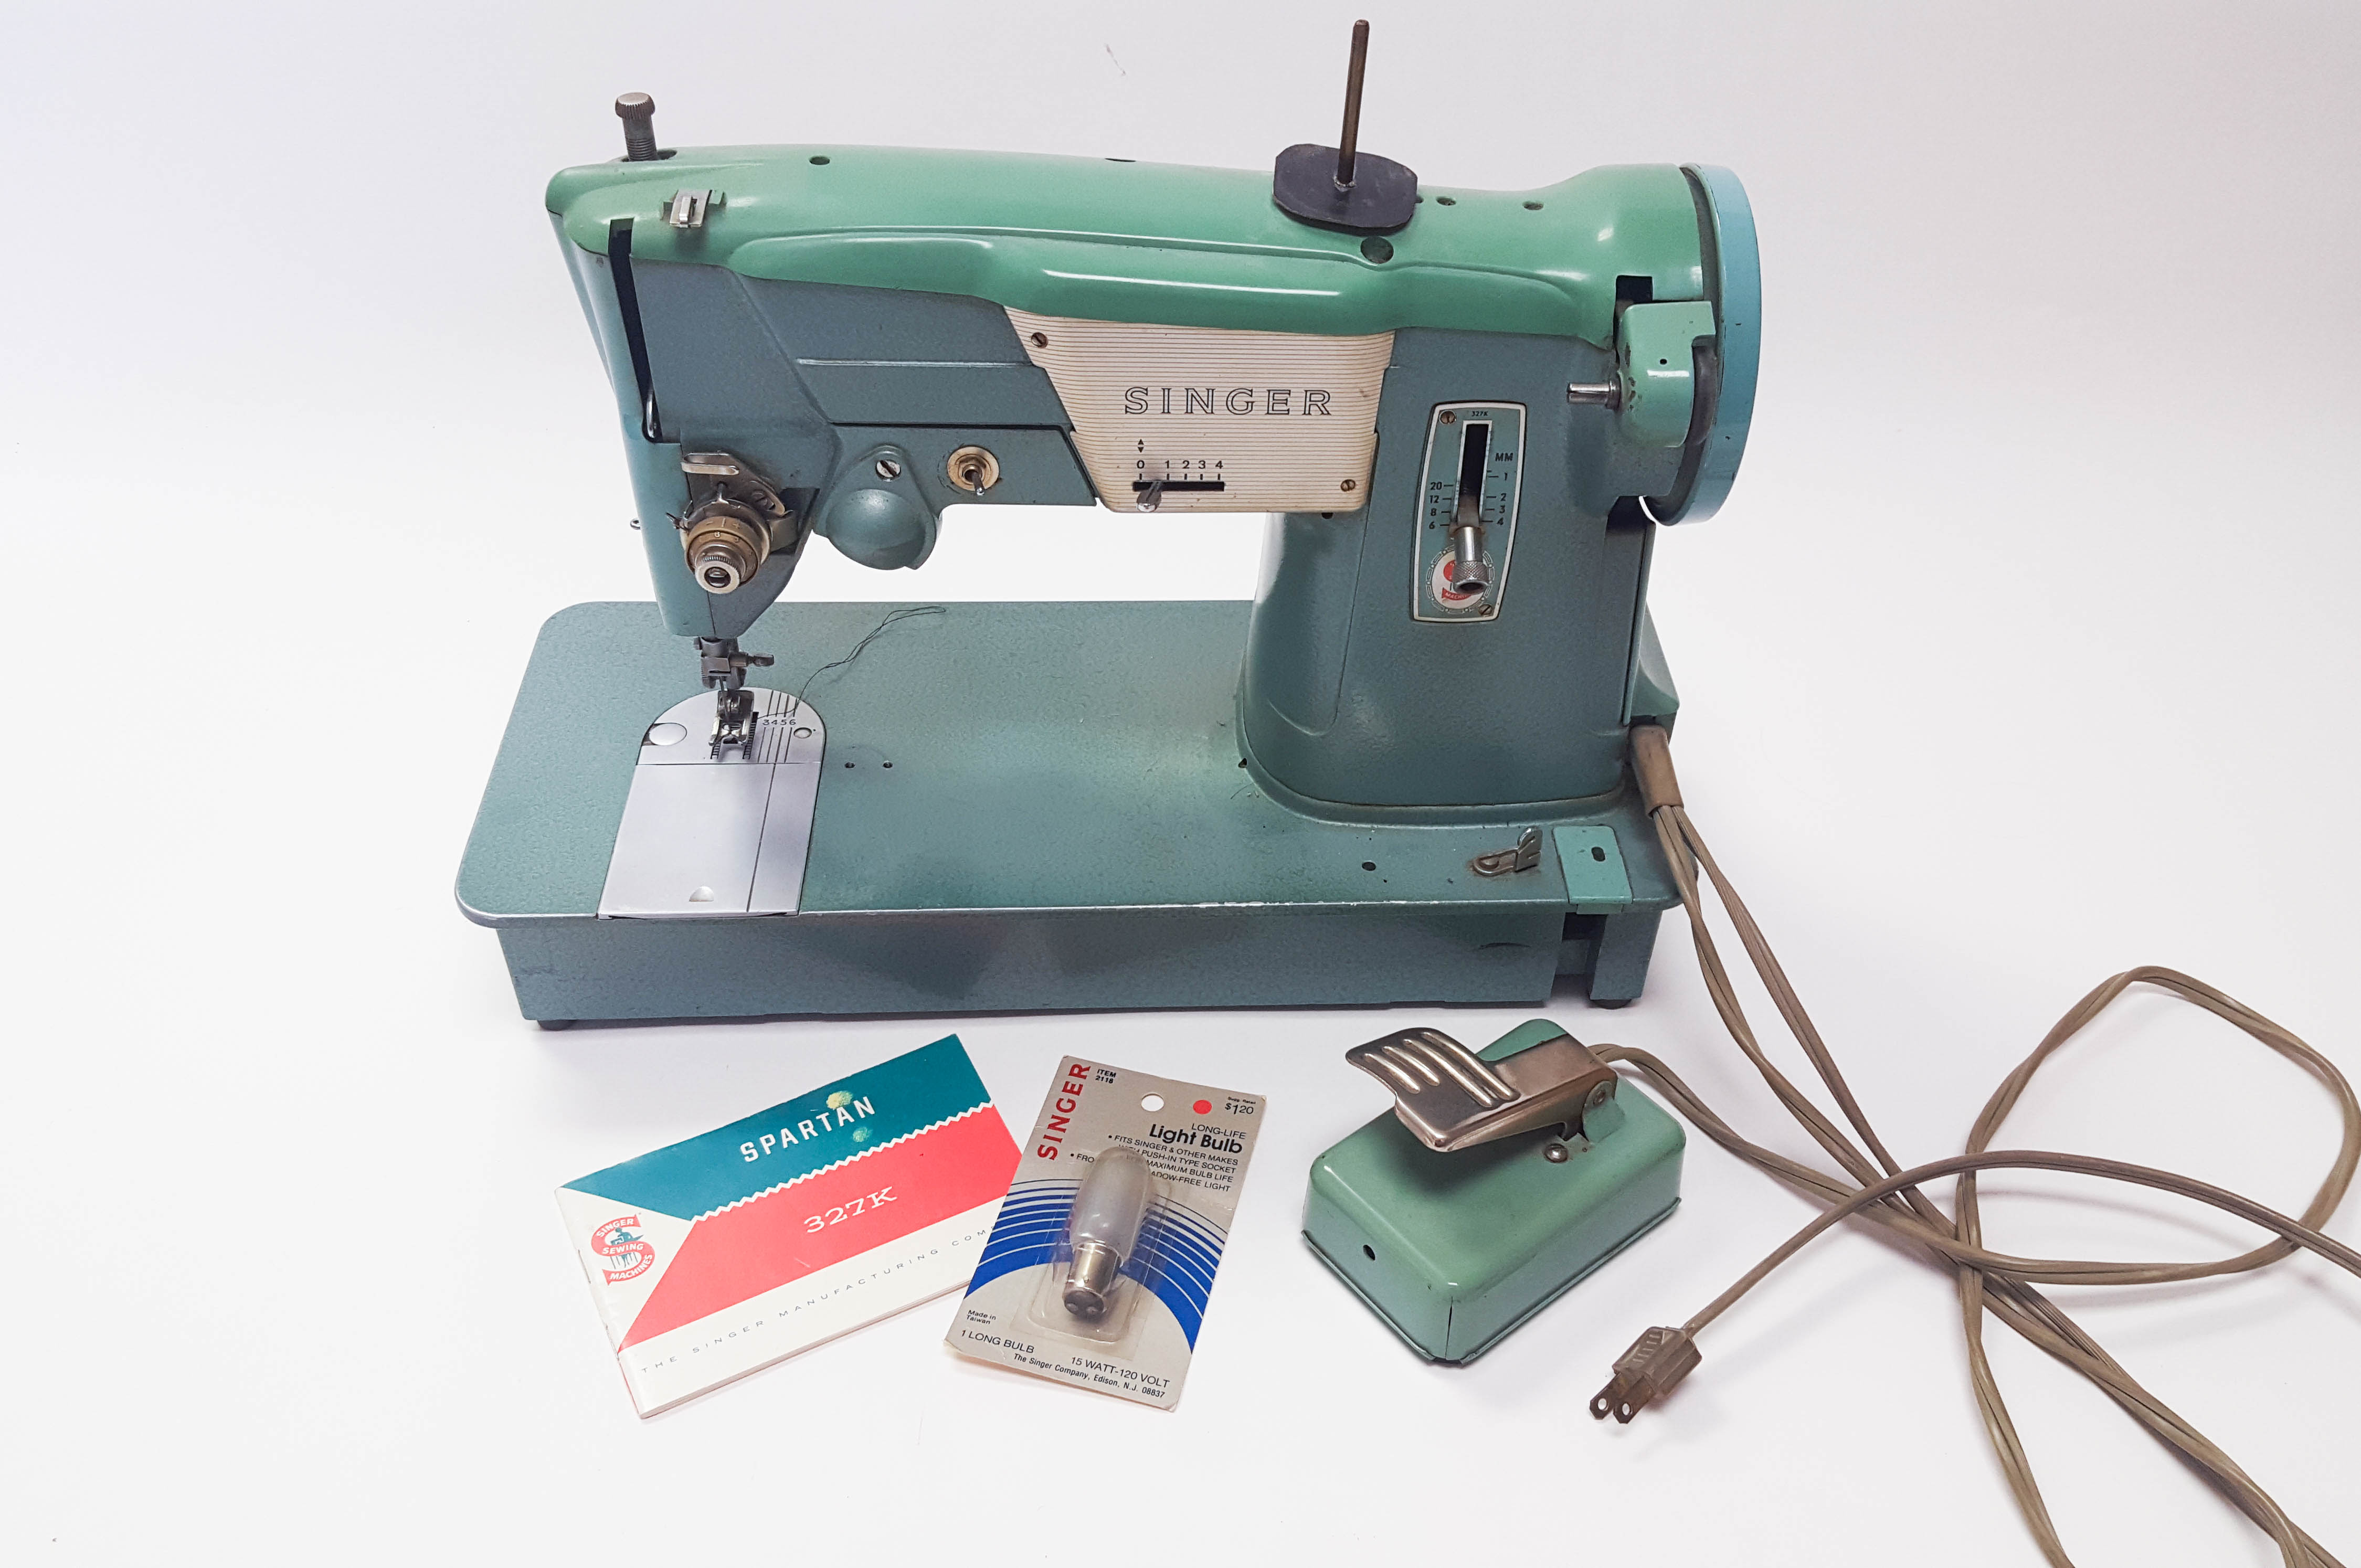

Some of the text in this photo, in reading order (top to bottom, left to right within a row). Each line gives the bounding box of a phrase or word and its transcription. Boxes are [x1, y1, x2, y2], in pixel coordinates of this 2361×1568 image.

[1125, 387, 1331, 416] SINGER
[1137, 460, 1223, 469] 0 1 2 3 4
[1495, 452, 1513, 462] MM
[1430, 482, 1442, 490] 20
[1430, 495, 1439, 503] 12
[1500, 493, 1507, 501] 2
[1499, 505, 1505, 514] 3
[1497, 517, 1504, 525] 4
[1095, 1075, 1114, 1084] 2118
[1097, 1069, 1117, 1078] ITEM
[1037, 1064, 1091, 1160] SINGER
[740, 1096, 875, 1162] SPARTAN
[1192, 1123, 1247, 1140] LONG-LIFE
[1149, 1124, 1243, 1153] Light Bulb
[1114, 1135, 1133, 1144] FITS
[1134, 1139, 1168, 1152] SINGER
[1177, 1148, 1206, 1160] OTHER
[1208, 1154, 1238, 1166] MAKES
[1141, 1149, 1177, 1163] PUSH-IN
[1179, 1157, 1200, 1167] TYPE
[1202, 1162, 1236, 1174] SOCKET
[1147, 1160, 1188, 1174] MAXIMUM
[1189, 1169, 1213, 1179] BULB
[1214, 1174, 1234, 1183] LIFE
[1204, 1183, 1231, 1192] LIGHT
[804, 1186, 897, 1233] 327K
[596, 1219, 634, 1237] SINGER
[602, 1244, 644, 1254] SEWING
[610, 1254, 653, 1280] MACHINES
[642, 1227, 994, 1373] THE SINGER MANUFACTURING COM
[966, 1315, 991, 1325] Taiwan
[968, 1310, 988, 1318] Made
[968, 1331, 1001, 1345] LONG
[1003, 1339, 1035, 1353] BULB
[1014, 1353, 1027, 1363] The
[1029, 1358, 1053, 1369] Singer
[1055, 1364, 1090, 1381] Company,
[1123, 1382, 1138, 1392] N.J.
[1142, 1387, 1165, 1398] 08837
[1071, 1357, 1170, 1388] 15 WATT-120 VOLT
